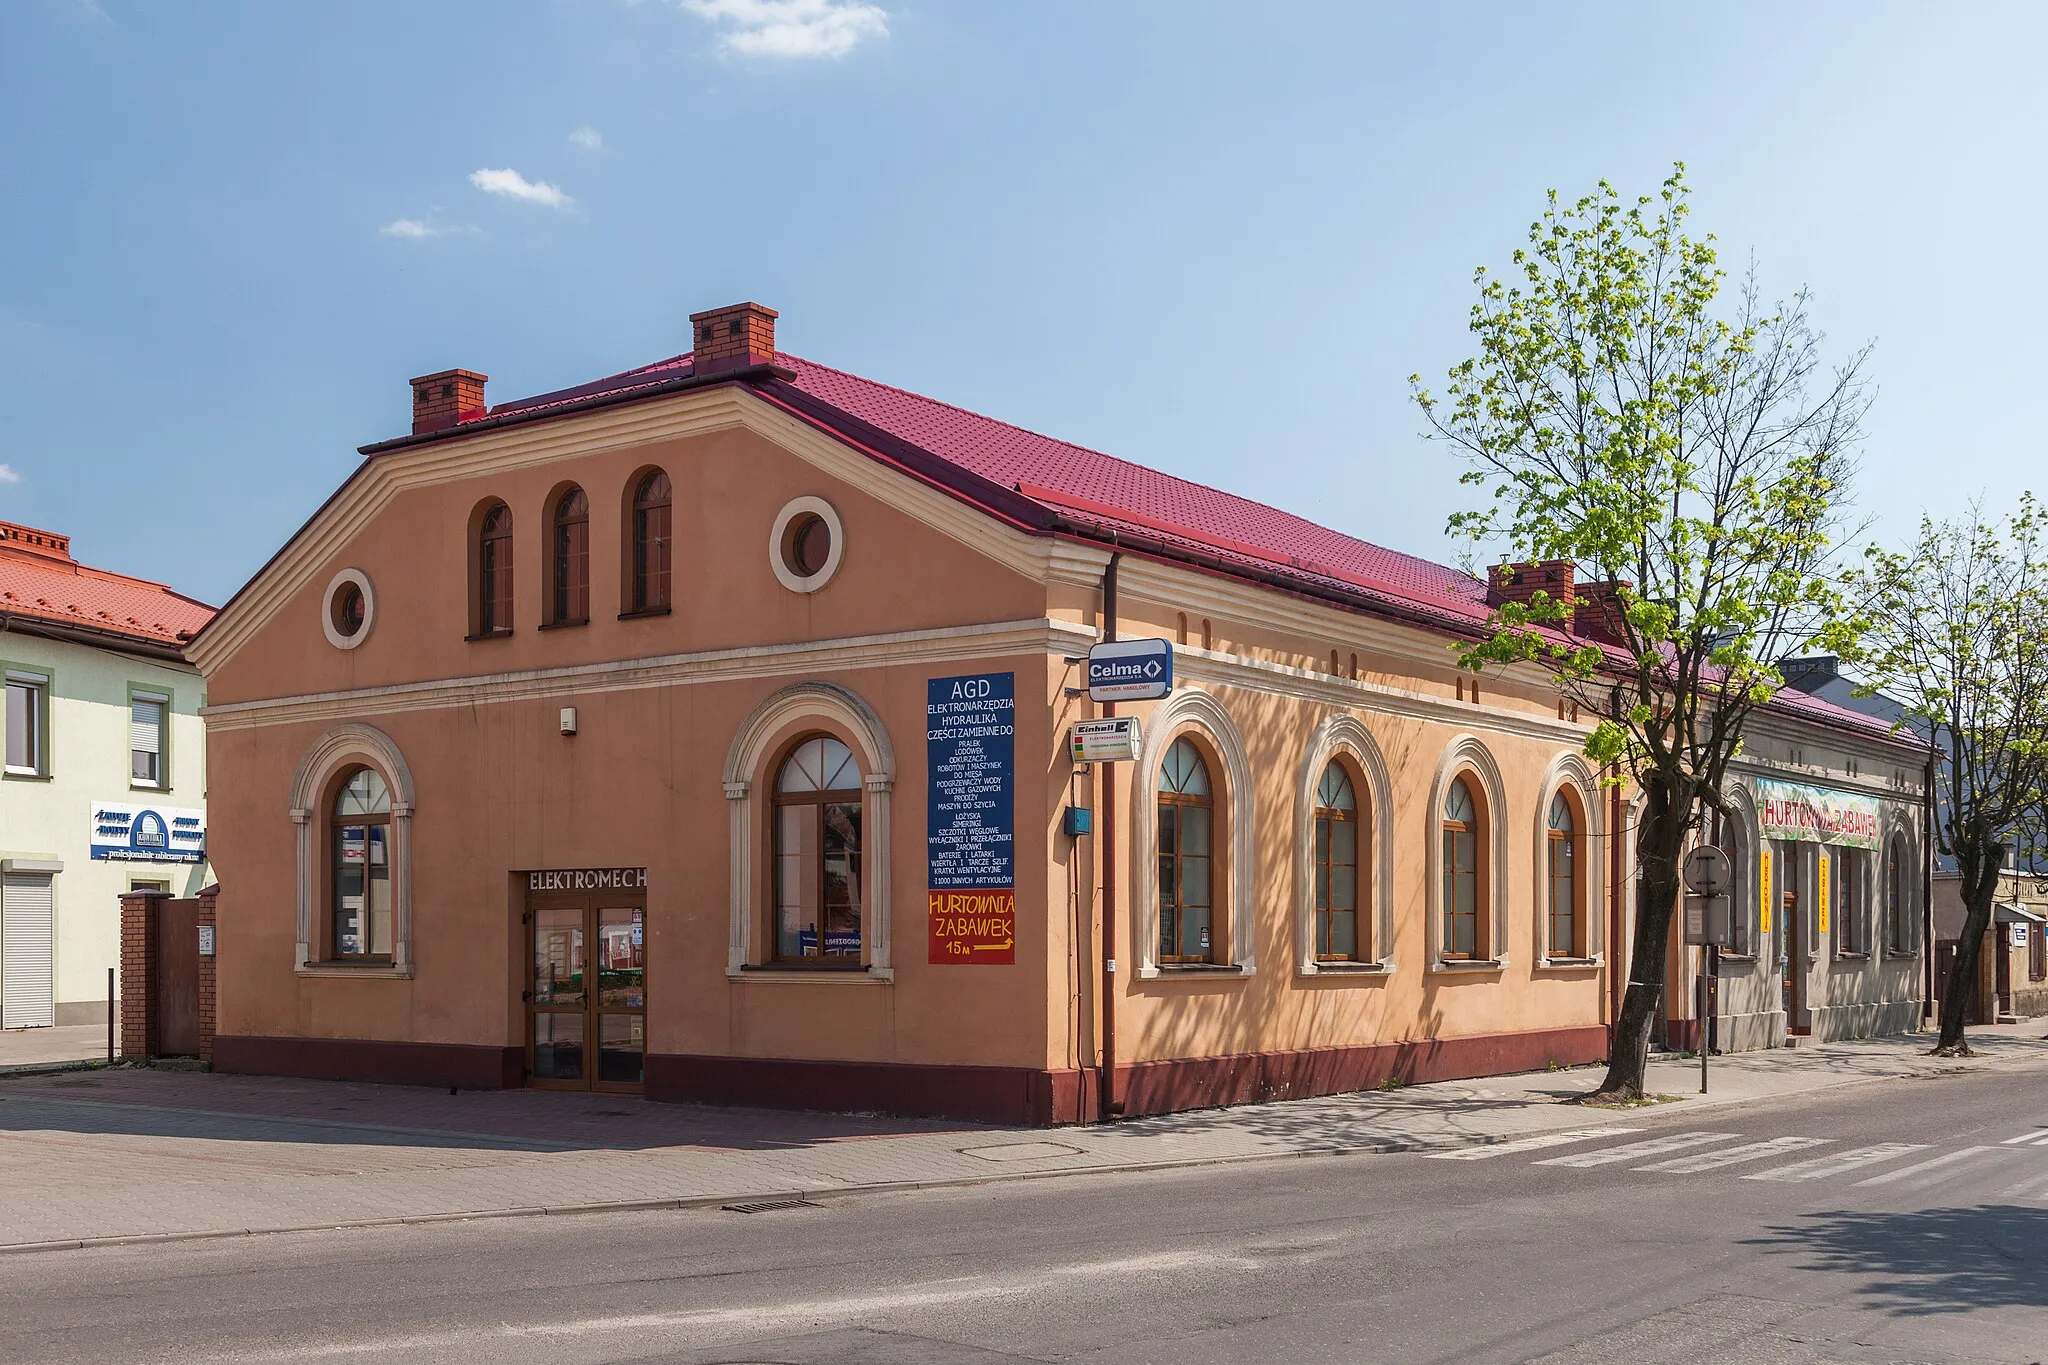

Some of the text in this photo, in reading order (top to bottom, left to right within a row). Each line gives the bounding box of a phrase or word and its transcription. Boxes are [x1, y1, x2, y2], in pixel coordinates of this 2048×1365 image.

[1090, 663, 1141, 678] Celma
[951, 679, 990, 700] AGD
[927, 698, 1014, 714] ELEKTRONARZĘDZIA
[942, 713, 997, 726] HYDRAULIKA
[927, 726, 956, 741] CZĘŚCI
[958, 726, 999, 738] ZAMIENNE
[1077, 724, 1114, 734] Einhell
[955, 747, 983, 755] LODÓWEK
[949, 755, 987, 764] ODKURZACZY
[937, 763, 965, 772] ROBOTÓW
[971, 762, 1002, 770] MASZYNEK
[936, 777, 1002, 788] PODGRZEWACZY WODY
[944, 785, 1001, 795] KUCHNI GAZOWYCH
[937, 803, 961, 811] MASZYN
[974, 801, 996, 809] SZYCIA
[1765, 799, 1833, 831] HURTOWNIA
[938, 827, 999, 836] SZCZOTKI WĘGLOWE
[108, 849, 155, 861] profesjonalnie
[938, 851, 961, 859] BATERIE
[931, 859, 957, 868] WIERTŁA
[968, 858, 988, 866] TARCZE
[934, 866, 1001, 875] KRATKI WENTYLACYJNE
[530, 868, 648, 890] ELEKTROMECH
[929, 894, 1015, 915] HURTOWNIA
[935, 918, 1012, 937] ZABAWEK
